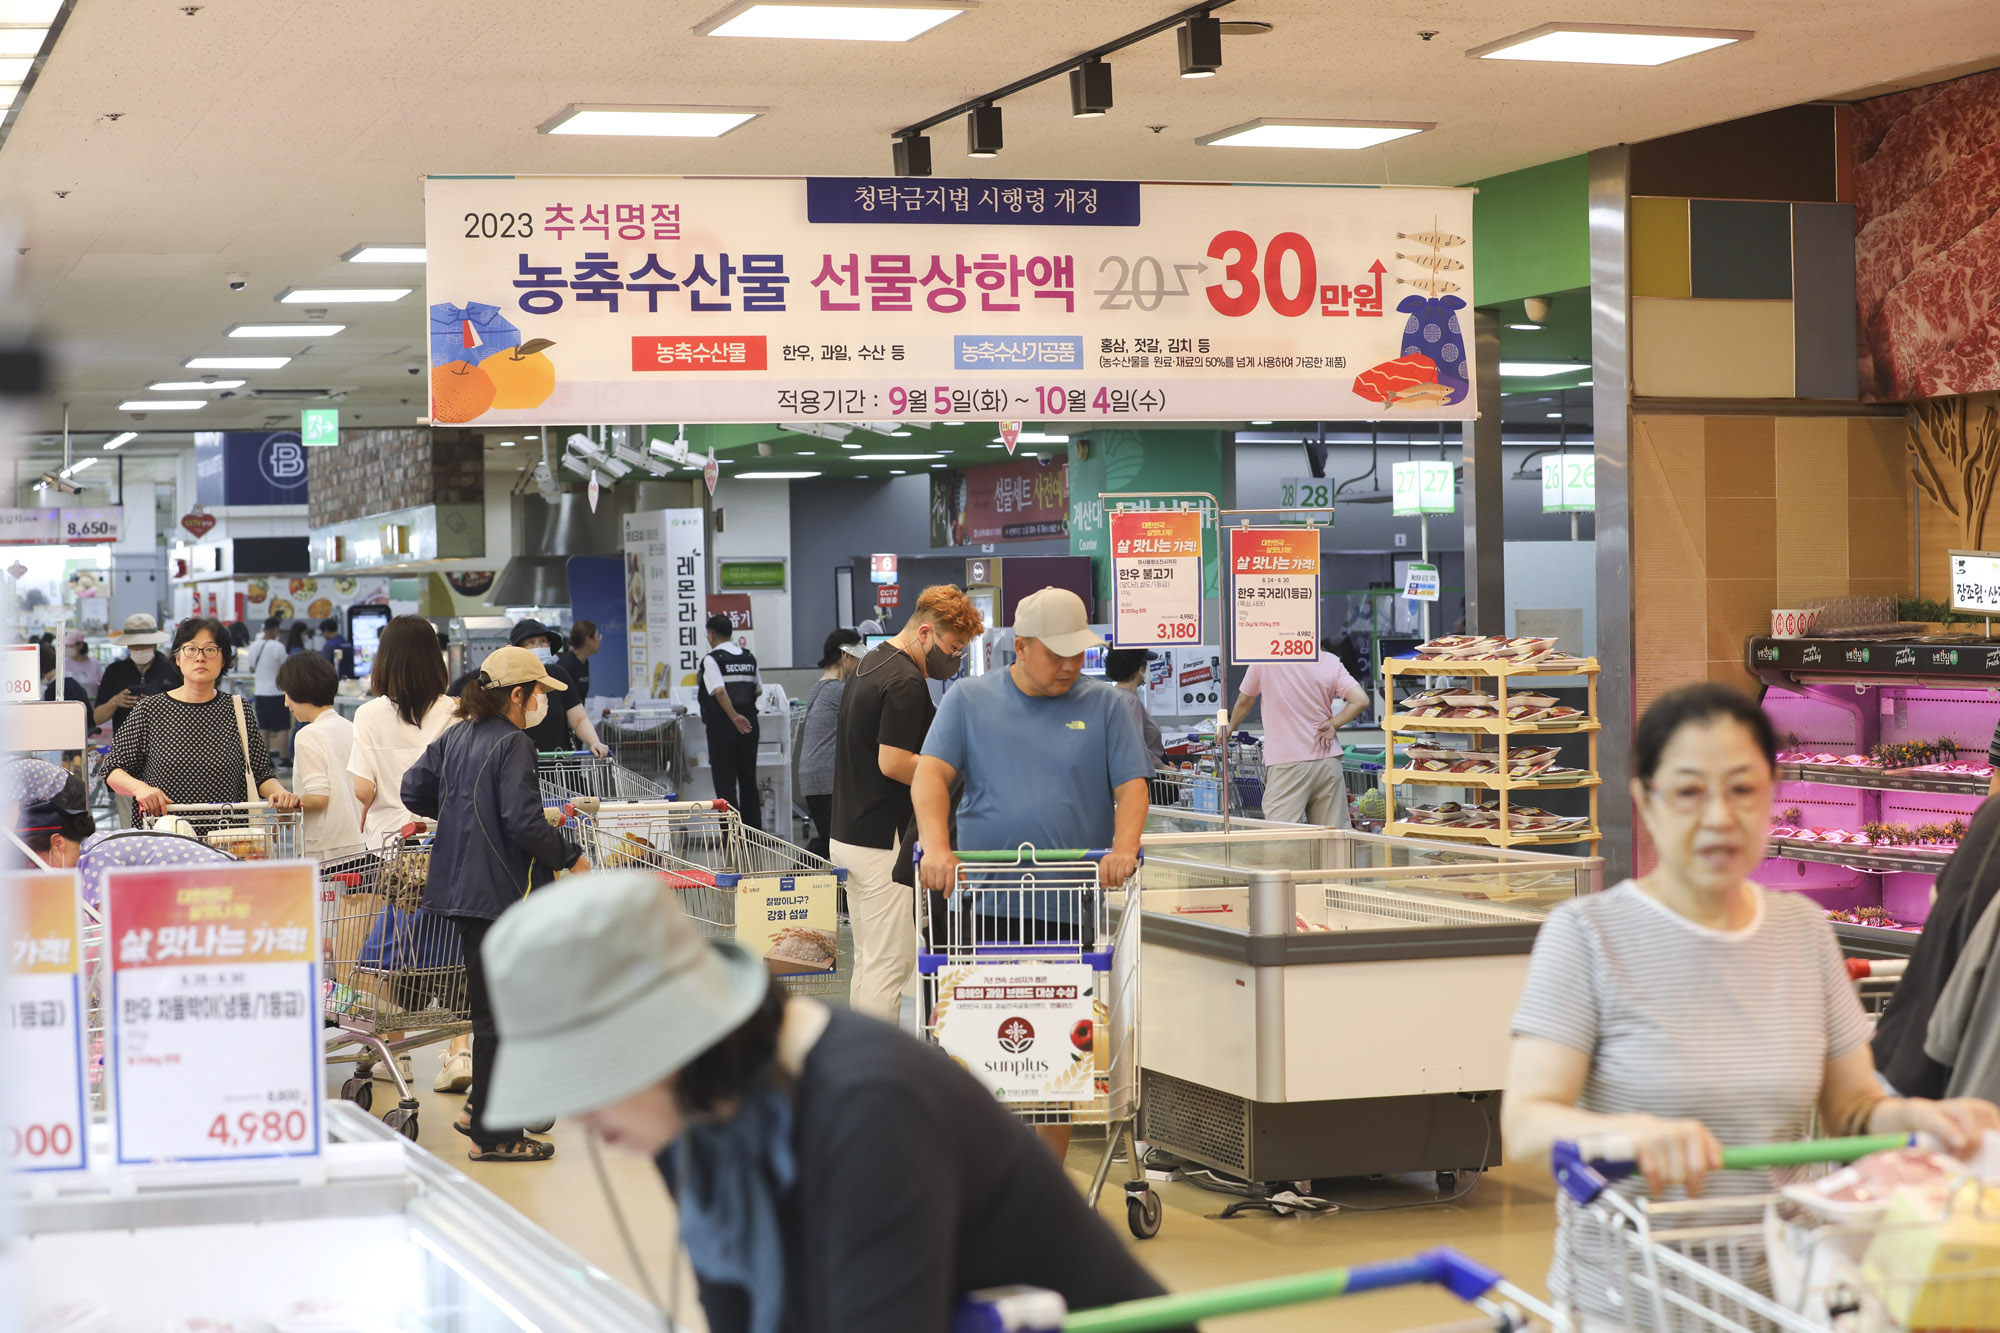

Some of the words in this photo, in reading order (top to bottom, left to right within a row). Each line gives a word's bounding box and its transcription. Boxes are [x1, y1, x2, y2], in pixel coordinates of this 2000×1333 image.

[854, 185, 969, 212] 청탁금지법
[978, 186, 1045, 213] 시행령
[1054, 188, 1098, 214] 개정
[463, 212, 535, 239] 2023
[543, 203, 682, 241] 추석명절
[512, 252, 790, 315] 농축수산물
[810, 252, 1076, 314] 선물상한액
[1098, 255, 1164, 312] 20
[656, 342, 747, 364] 농축수산물
[782, 344, 814, 362] 한우,
[821, 344, 852, 362] 과일,
[857, 345, 886, 361] 수산
[891, 345, 905, 360] 등
[961, 341, 1076, 364] 농축수산가공품
[1100, 338, 1129, 354] 홍삼,
[1134, 338, 1163, 354] 젓갈,
[1168, 338, 1192, 353] 김치
[1198, 338, 1211, 353] 등
[1099, 356, 1150, 368] (농수산물을
[1205, 356, 1235, 368] 50%를
[1236, 356, 1255, 368] 넘게
[1257, 356, 1294, 369] 사용하여
[1295, 356, 1323, 369] 가공한
[1324, 356, 1347, 369] 제품)
[777, 389, 866, 414] 적용기간
[888, 386, 928, 415] 9월
[934, 387, 1008, 415] 5일(화)
[1035, 386, 1087, 415] 10월
[1092, 386, 1166, 414] 4일(수)
[1396, 470, 1416, 494] 27
[1424, 470, 1449, 492] 27
[1544, 464, 1560, 489] 26
[1568, 463, 1595, 488] 26
[995, 476, 1033, 512] 선물세트
[1281, 484, 1295, 507] 28
[1300, 485, 1329, 507] 28
[1073, 499, 1103, 531] 계산대
[1079, 539, 1098, 551] Counter
[1117, 539, 1132, 554] 살
[1133, 539, 1172, 553] 맛나는
[1174, 540, 1197, 553] 가격!
[882, 556, 893, 570] 6
[1236, 555, 1251, 570] 살
[1252, 555, 1291, 570] 맛나는
[1292, 556, 1315, 570] 가격!
[1119, 568, 1140, 580] 한우
[1143, 568, 1174, 580] 불고기
[1237, 588, 1255, 599] 한우
[1257, 587, 1312, 600] 국거리(1등급)
[677, 556, 700, 670] 레몬라테라
[1157, 622, 1197, 640] 3,180
[1270, 639, 1314, 657] 2,880
[725, 663, 755, 673] SECURITY
[1183, 660, 1205, 669] Energizer
[767, 910, 787, 921] 강화
[789, 909, 808, 920] 섬쌀
[955, 987, 985, 999] 올해의
[985, 987, 1005, 999] 과일
[1006, 987, 1035, 999] 브랜드
[1035, 986, 1055, 999] 대상
[1056, 986, 1076, 998] 수상
[985, 1057, 1049, 1076] sunplus
[207, 1109, 307, 1147] 4,980
